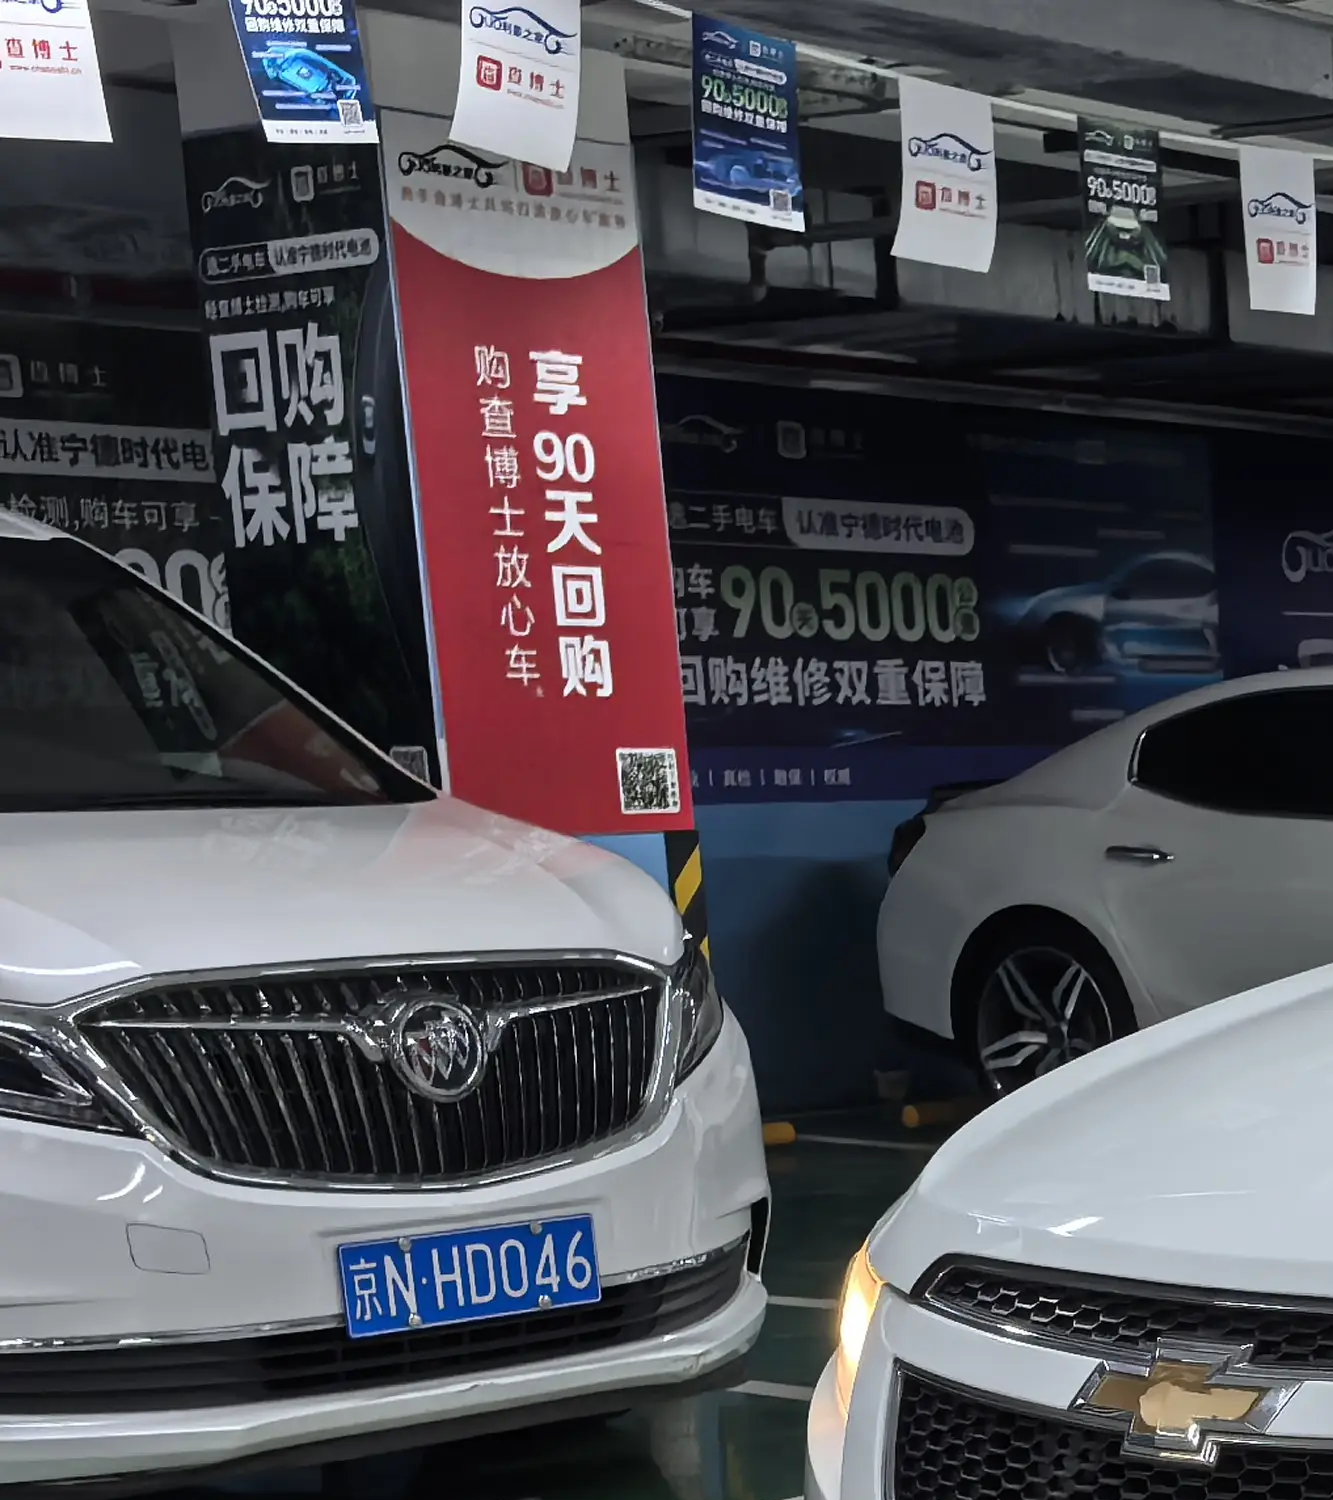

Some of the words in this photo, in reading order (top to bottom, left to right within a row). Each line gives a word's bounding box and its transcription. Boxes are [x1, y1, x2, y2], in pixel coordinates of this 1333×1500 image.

[209, 321, 347, 437] 回购
[221, 440, 359, 549] 保障
[680, 655, 988, 708] 回购维修双重保障
[347, 1230, 593, 1322] 京N·HD046
